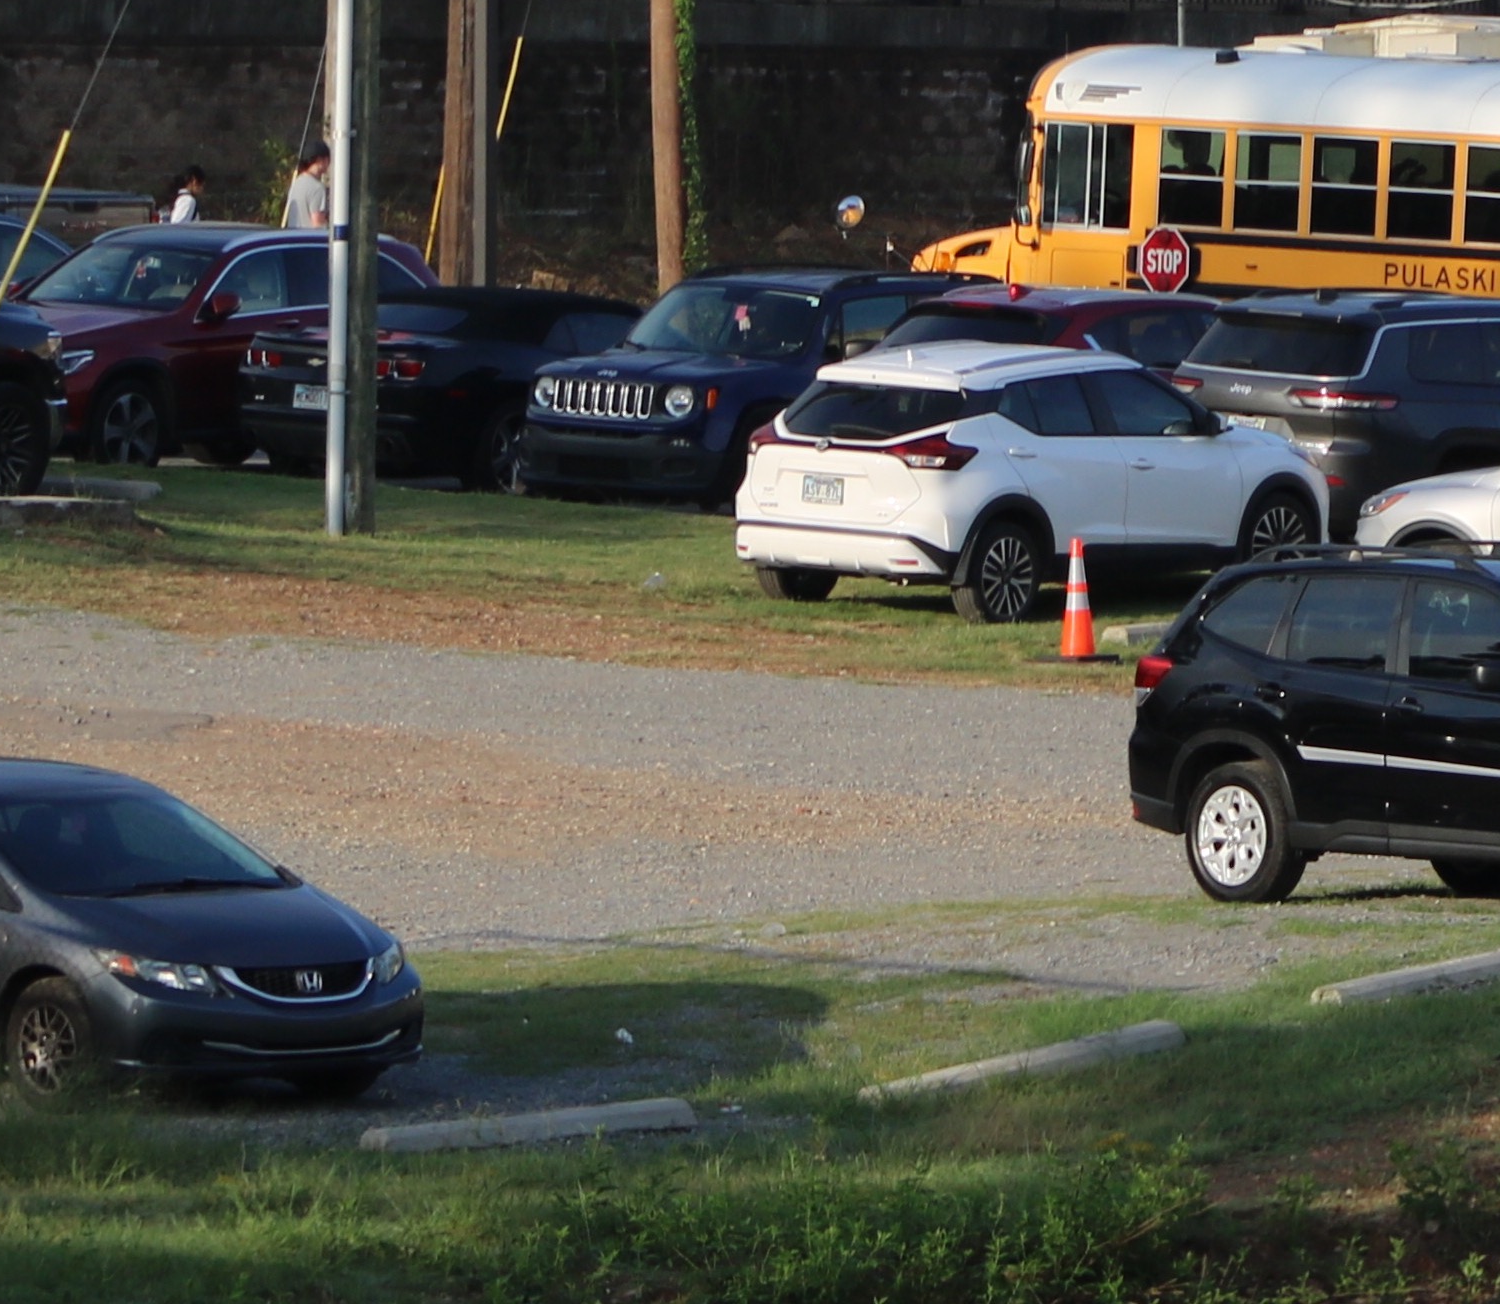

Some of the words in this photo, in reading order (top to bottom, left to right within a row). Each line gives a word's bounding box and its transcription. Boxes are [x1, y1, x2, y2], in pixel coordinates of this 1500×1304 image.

[1146, 248, 1182, 274] STOP
[1384, 262, 1495, 292] PULASKI
[1230, 382, 1252, 396] Jeep
